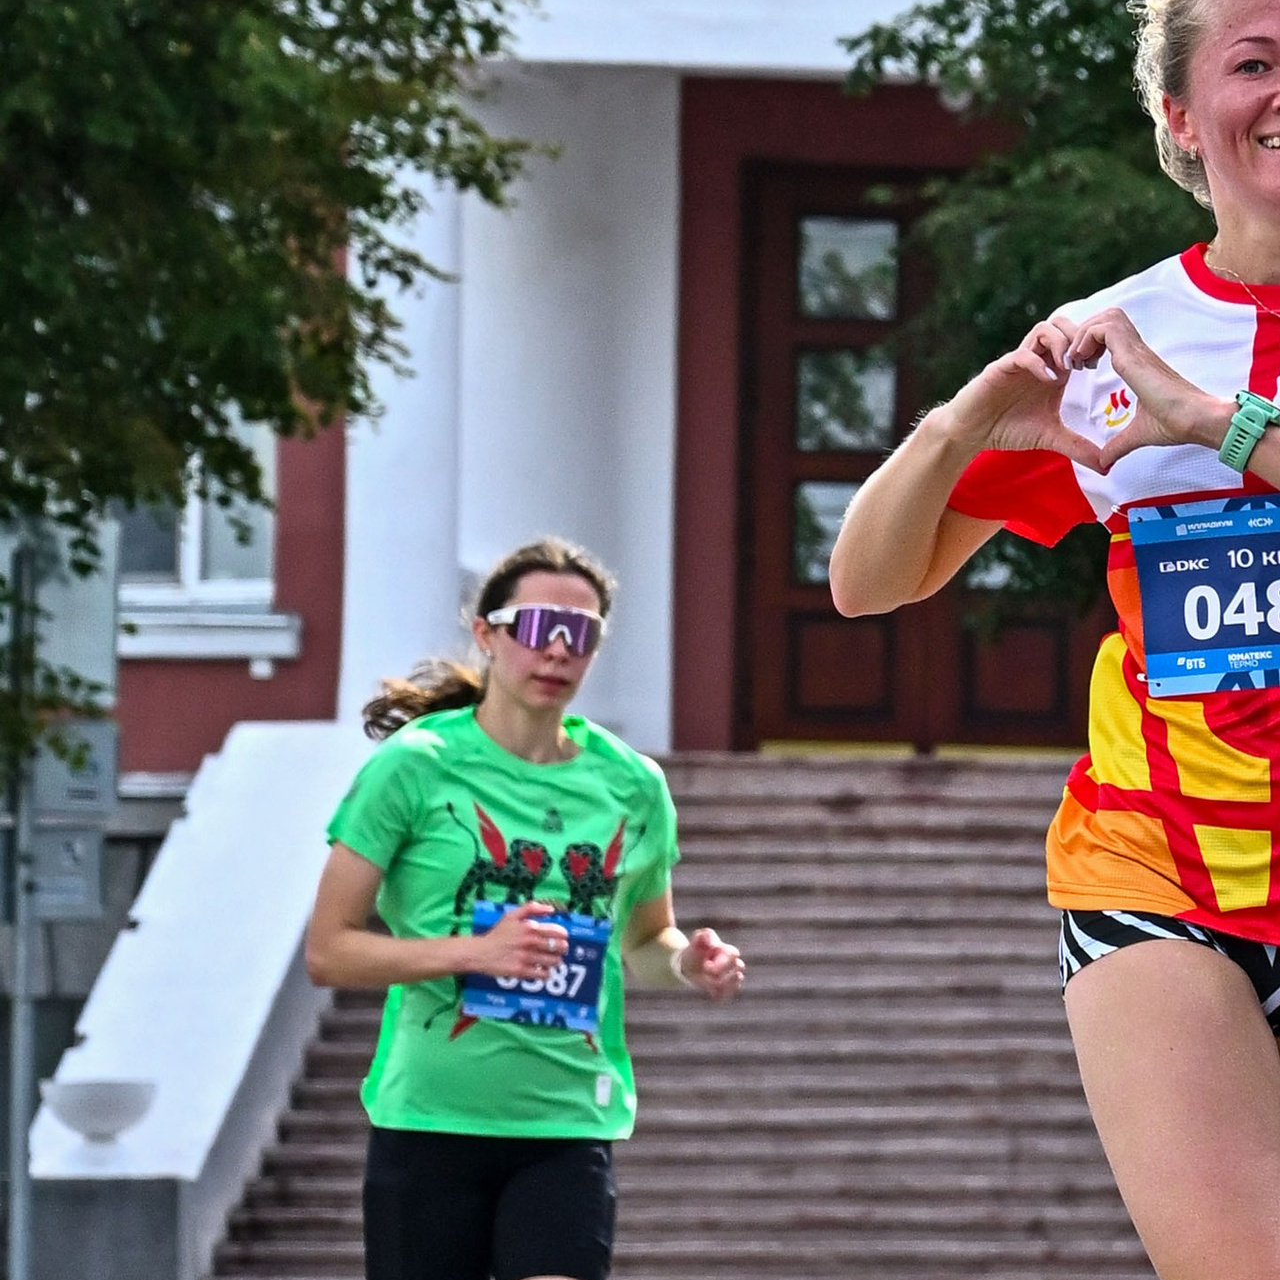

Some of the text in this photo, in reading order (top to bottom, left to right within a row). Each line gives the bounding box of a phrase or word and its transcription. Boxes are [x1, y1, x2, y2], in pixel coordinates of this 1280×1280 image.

[1176, 558, 1210, 572] DKC
[1227, 548, 1254, 569] 10
[1227, 650, 1273, 661] ЮНАТЕКС
[1186, 657, 1206, 670] ВТБ
[1229, 660, 1259, 669] ТЕРМО
